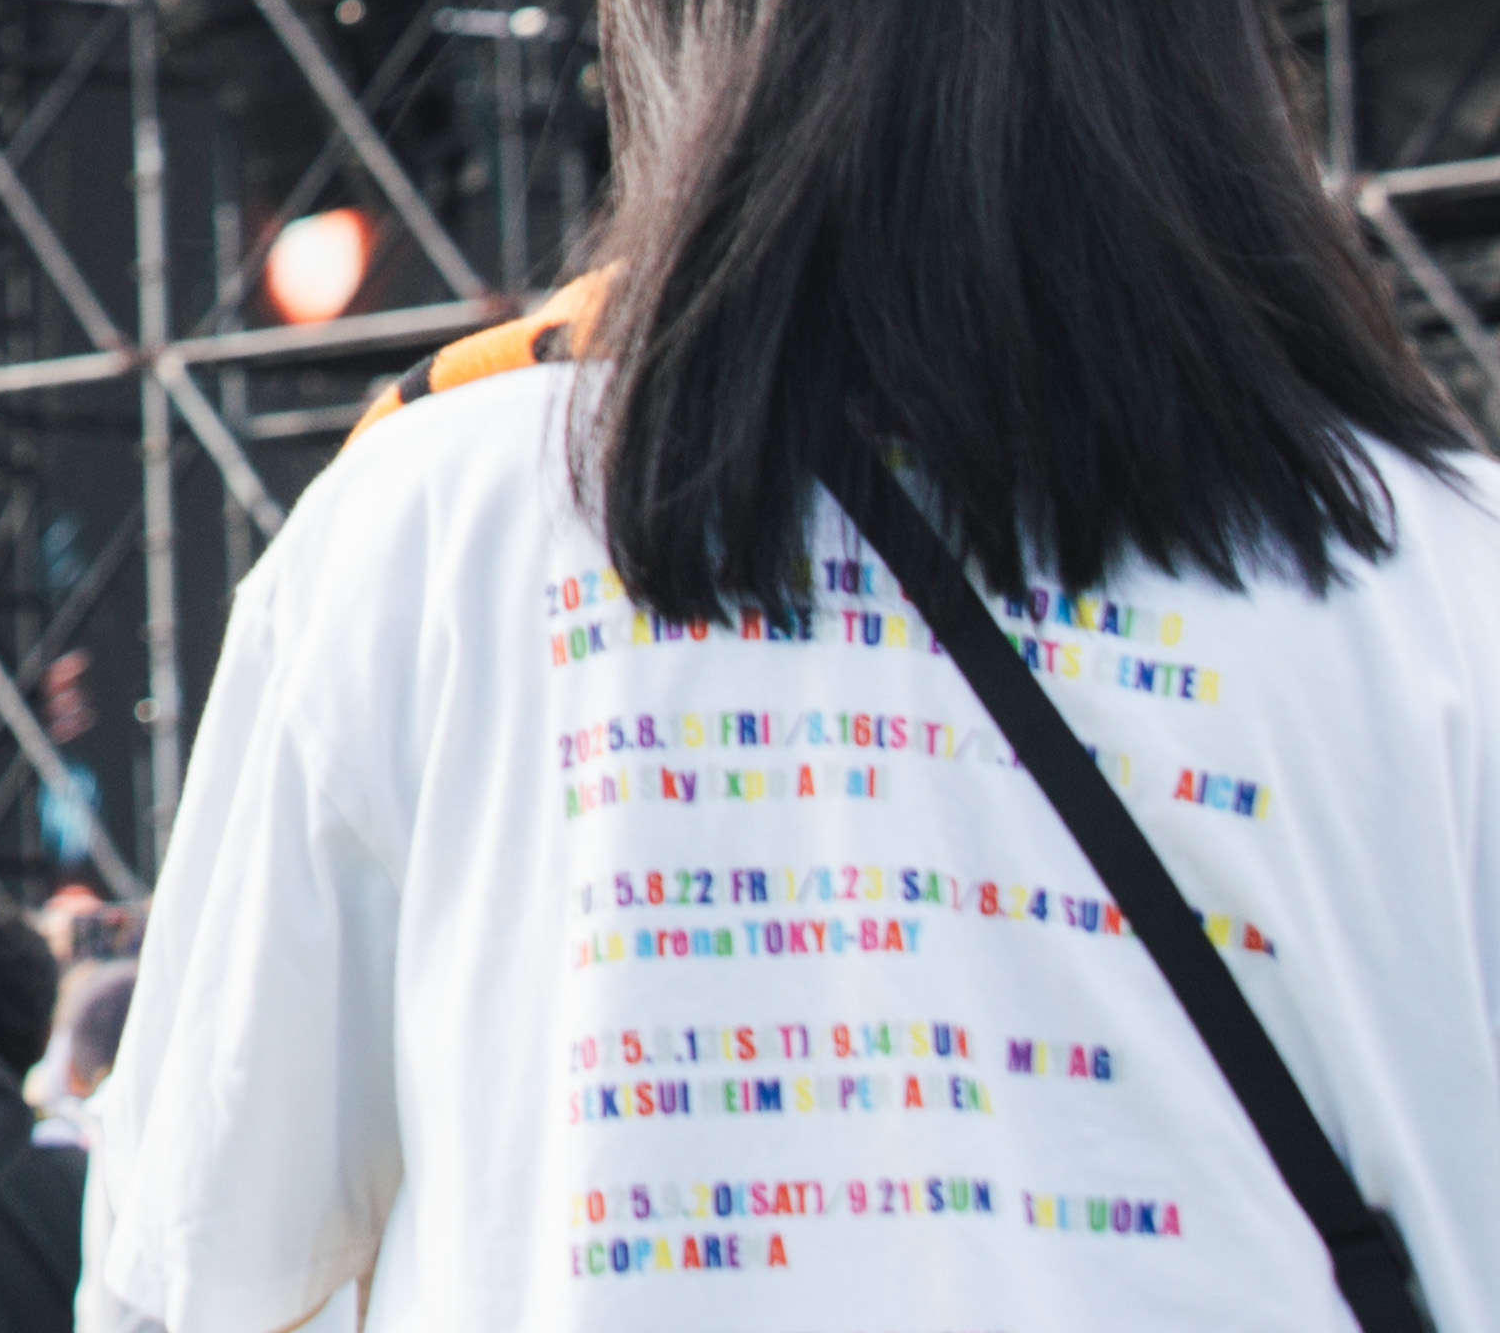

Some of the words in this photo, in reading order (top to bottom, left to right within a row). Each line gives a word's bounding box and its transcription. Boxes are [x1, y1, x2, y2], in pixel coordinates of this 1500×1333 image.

[634, 926, 734, 959] arena
[741, 917, 921, 957] TOKYO-BAY
[569, 1078, 692, 1124] SEKISUI
[569, 1235, 674, 1278] ECOPA
